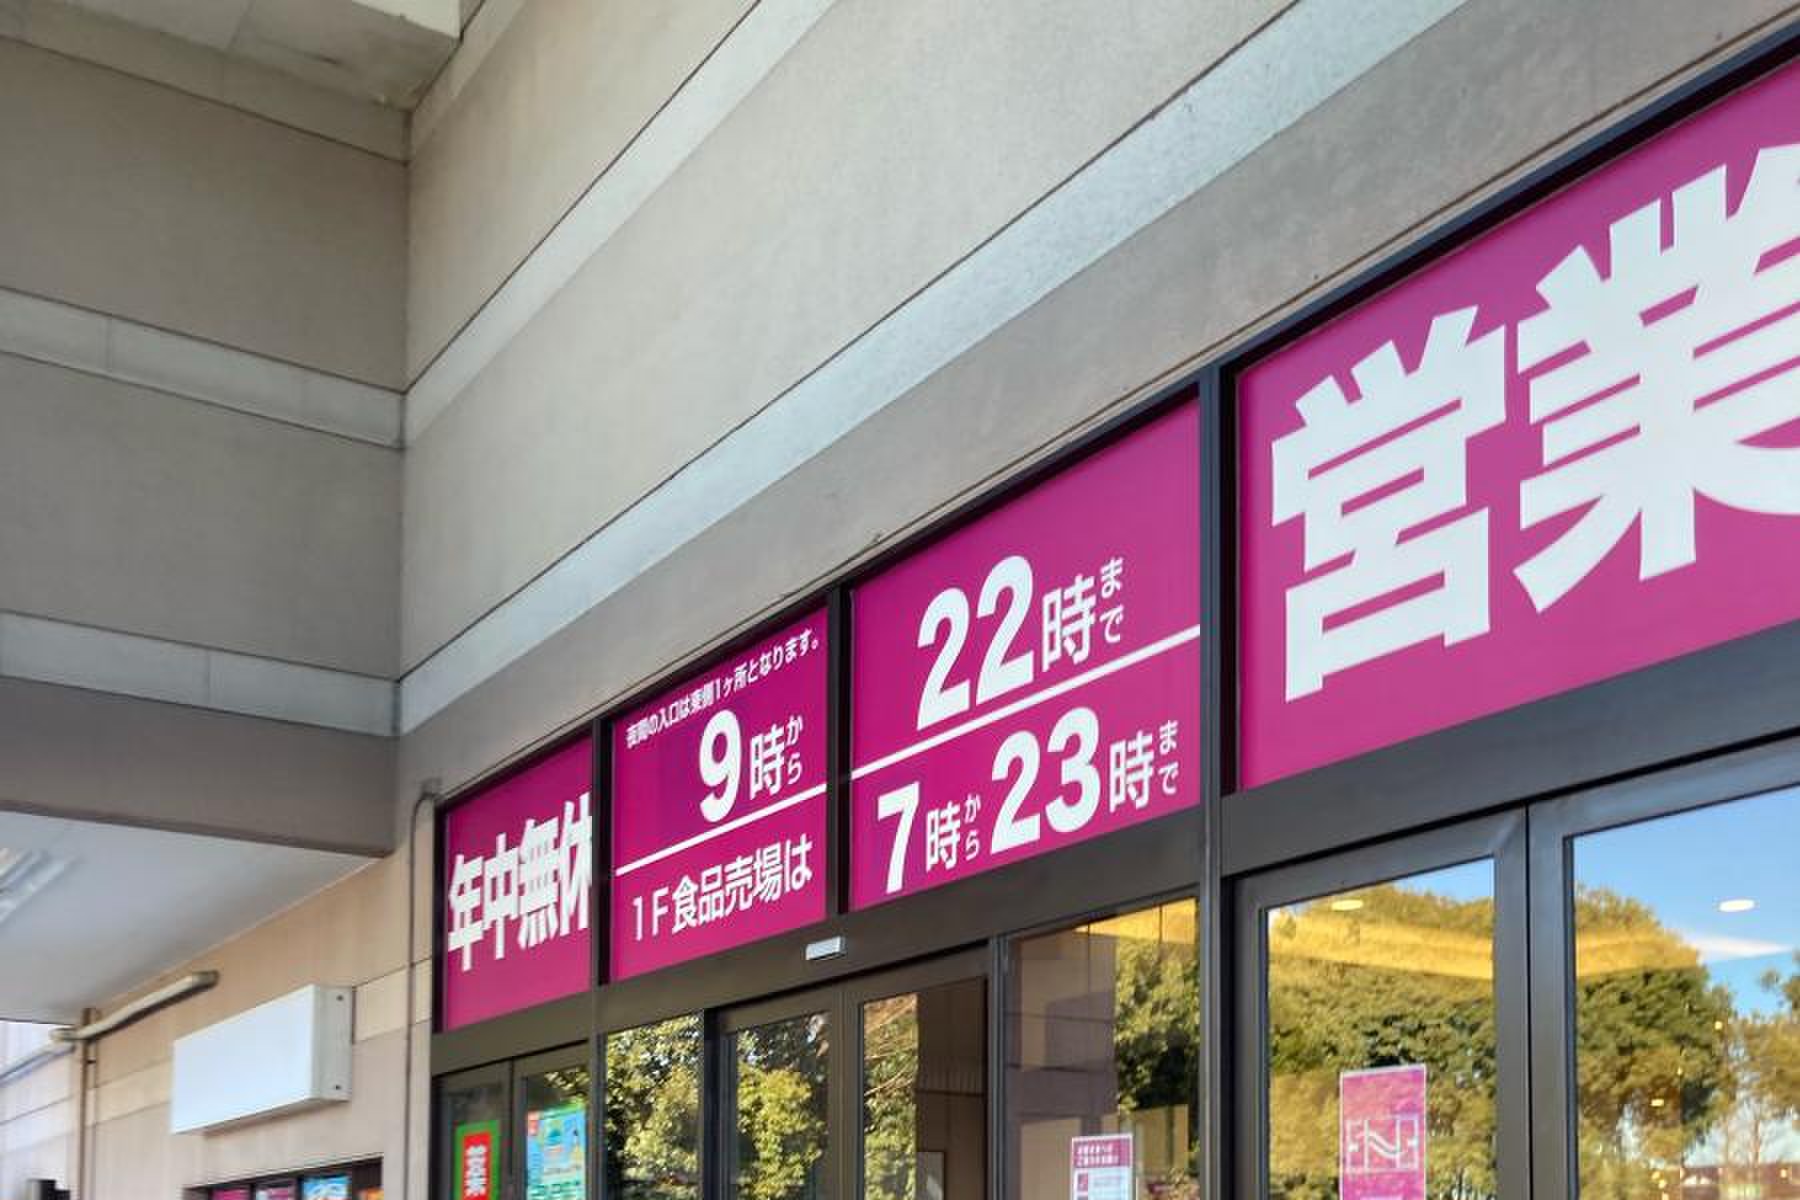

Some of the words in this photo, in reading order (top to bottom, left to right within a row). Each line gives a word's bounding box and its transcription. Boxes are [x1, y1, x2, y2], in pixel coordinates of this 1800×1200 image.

[1271, 142, 1800, 702] 営業
[448, 792, 592, 972] 年中無休
